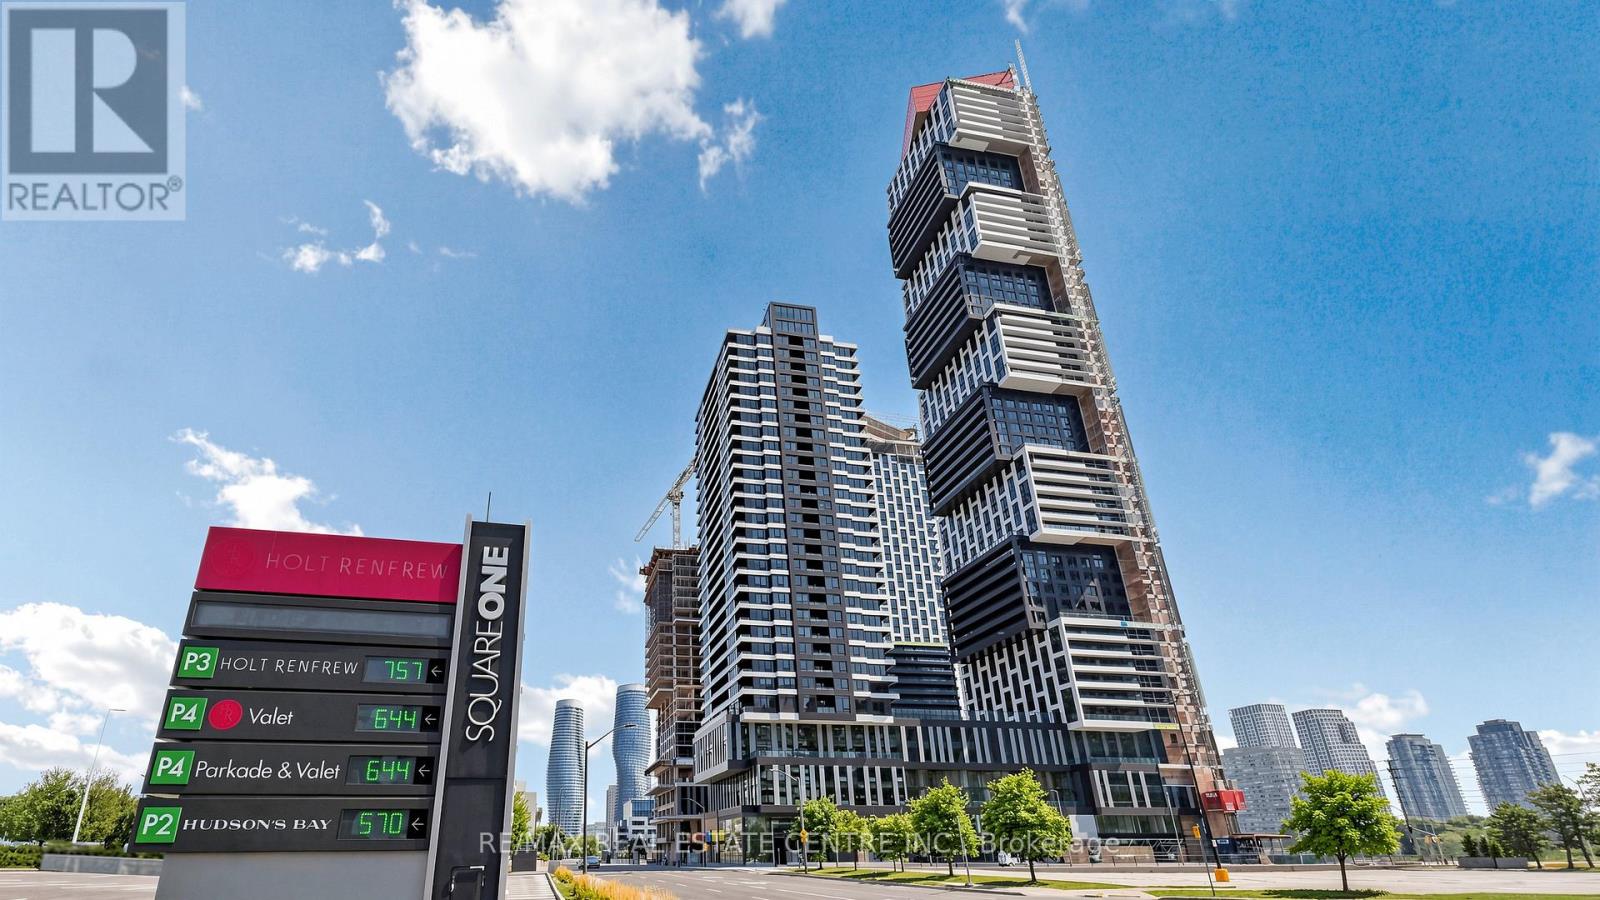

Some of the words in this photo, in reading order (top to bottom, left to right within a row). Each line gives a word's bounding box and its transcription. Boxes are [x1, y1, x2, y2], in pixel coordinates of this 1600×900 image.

[267, 553, 329, 572] HOLT
[340, 558, 448, 579] RENFREW
[184, 654, 210, 670] P3
[220, 657, 267, 672] HOLT
[275, 659, 358, 675] RENFREW
[384, 661, 422, 680] 757
[170, 703, 198, 721] P4
[249, 708, 293, 726] Valet
[374, 709, 417, 730] 644
[156, 757, 184, 776] P4
[195, 760, 274, 779] Parkade
[278, 762, 292, 778] &
[297, 761, 340, 779] Valet
[366, 760, 409, 781] 644
[145, 815, 173, 835] P2
[183, 819, 287, 831] HUDSON'S
[293, 819, 333, 831] BAY
[359, 812, 403, 836] 570
